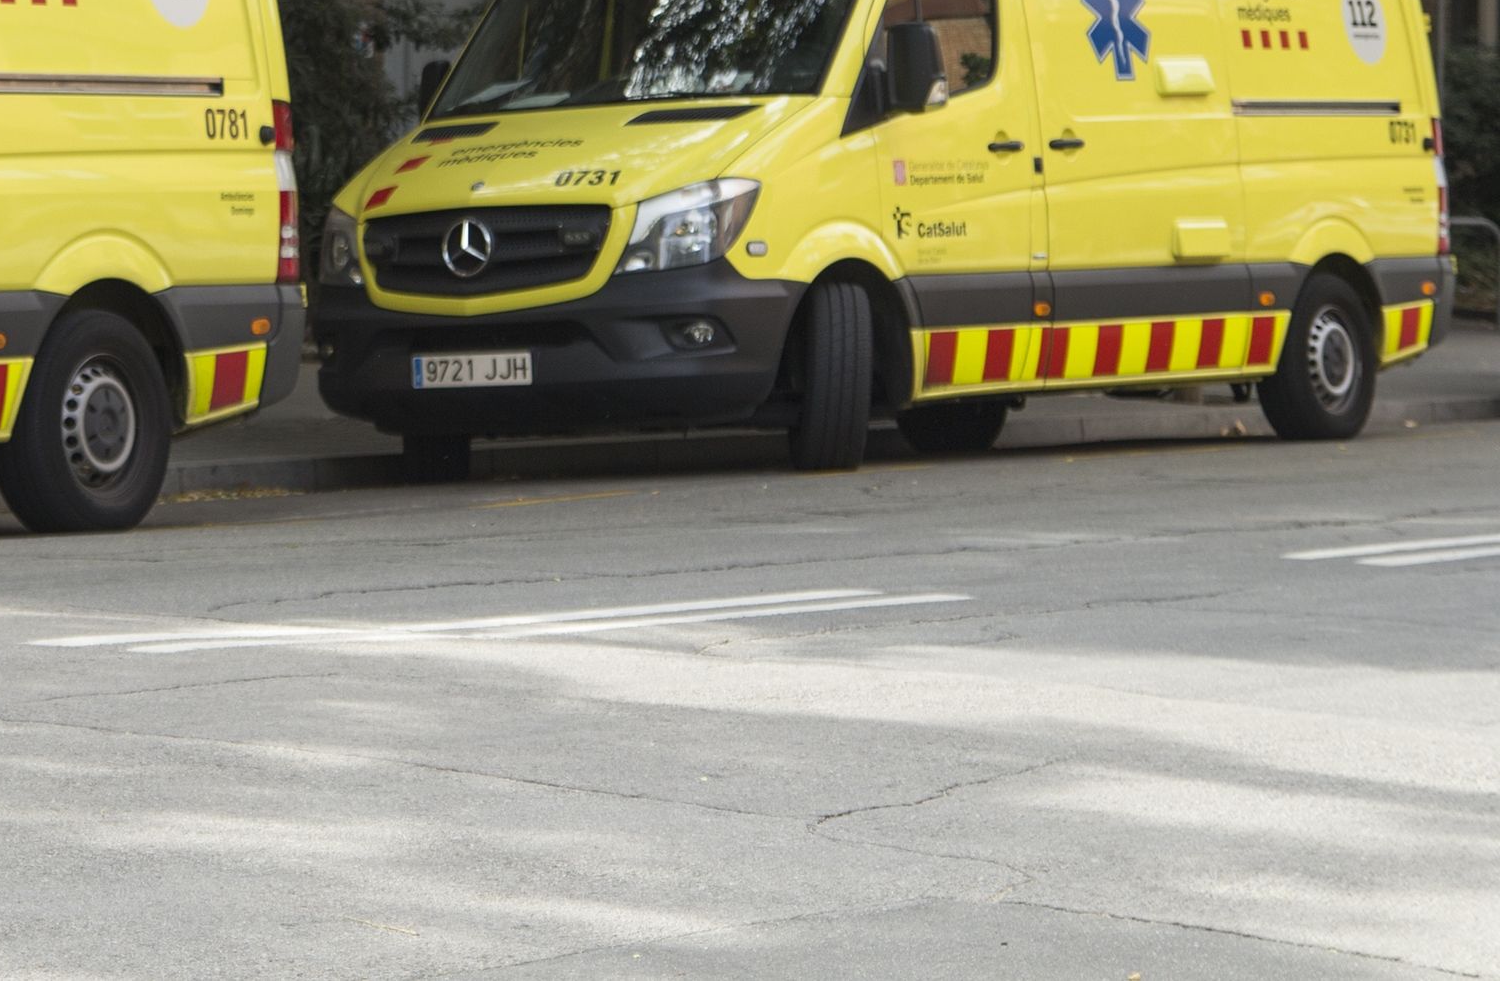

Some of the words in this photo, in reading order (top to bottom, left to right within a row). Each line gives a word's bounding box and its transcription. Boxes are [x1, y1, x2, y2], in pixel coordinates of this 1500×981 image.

[1348, 0, 1378, 28] 112
[205, 108, 248, 139] 0781
[1389, 121, 1416, 145] 0731
[555, 170, 621, 187] 0731
[918, 221, 967, 238] CatSalut
[426, 359, 474, 383] 9721
[485, 357, 528, 380] JJH
